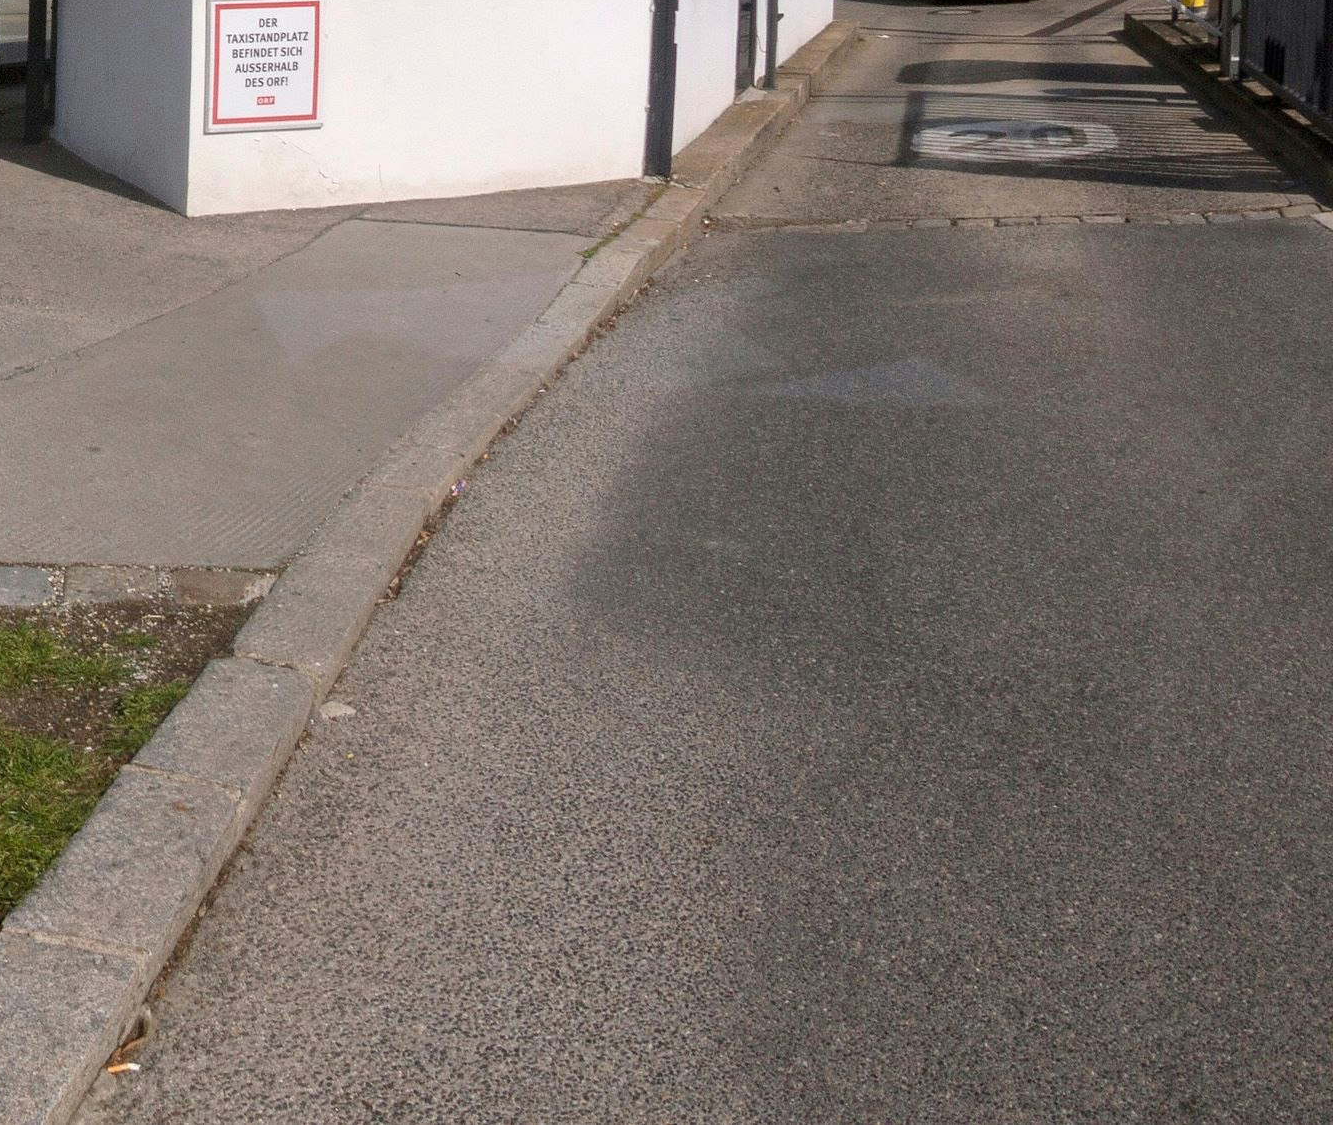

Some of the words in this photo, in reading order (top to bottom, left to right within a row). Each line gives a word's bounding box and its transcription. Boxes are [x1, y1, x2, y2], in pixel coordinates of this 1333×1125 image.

[258, 17, 278, 28] DER
[226, 31, 309, 44] TAXISTANDPLATZ
[232, 47, 279, 59] BEFINDET
[280, 46, 303, 57] SICH
[235, 61, 299, 73] AUSSERHALB
[245, 77, 264, 88] DES
[266, 76, 289, 87] ORF!
[257, 96, 275, 105] ORF
